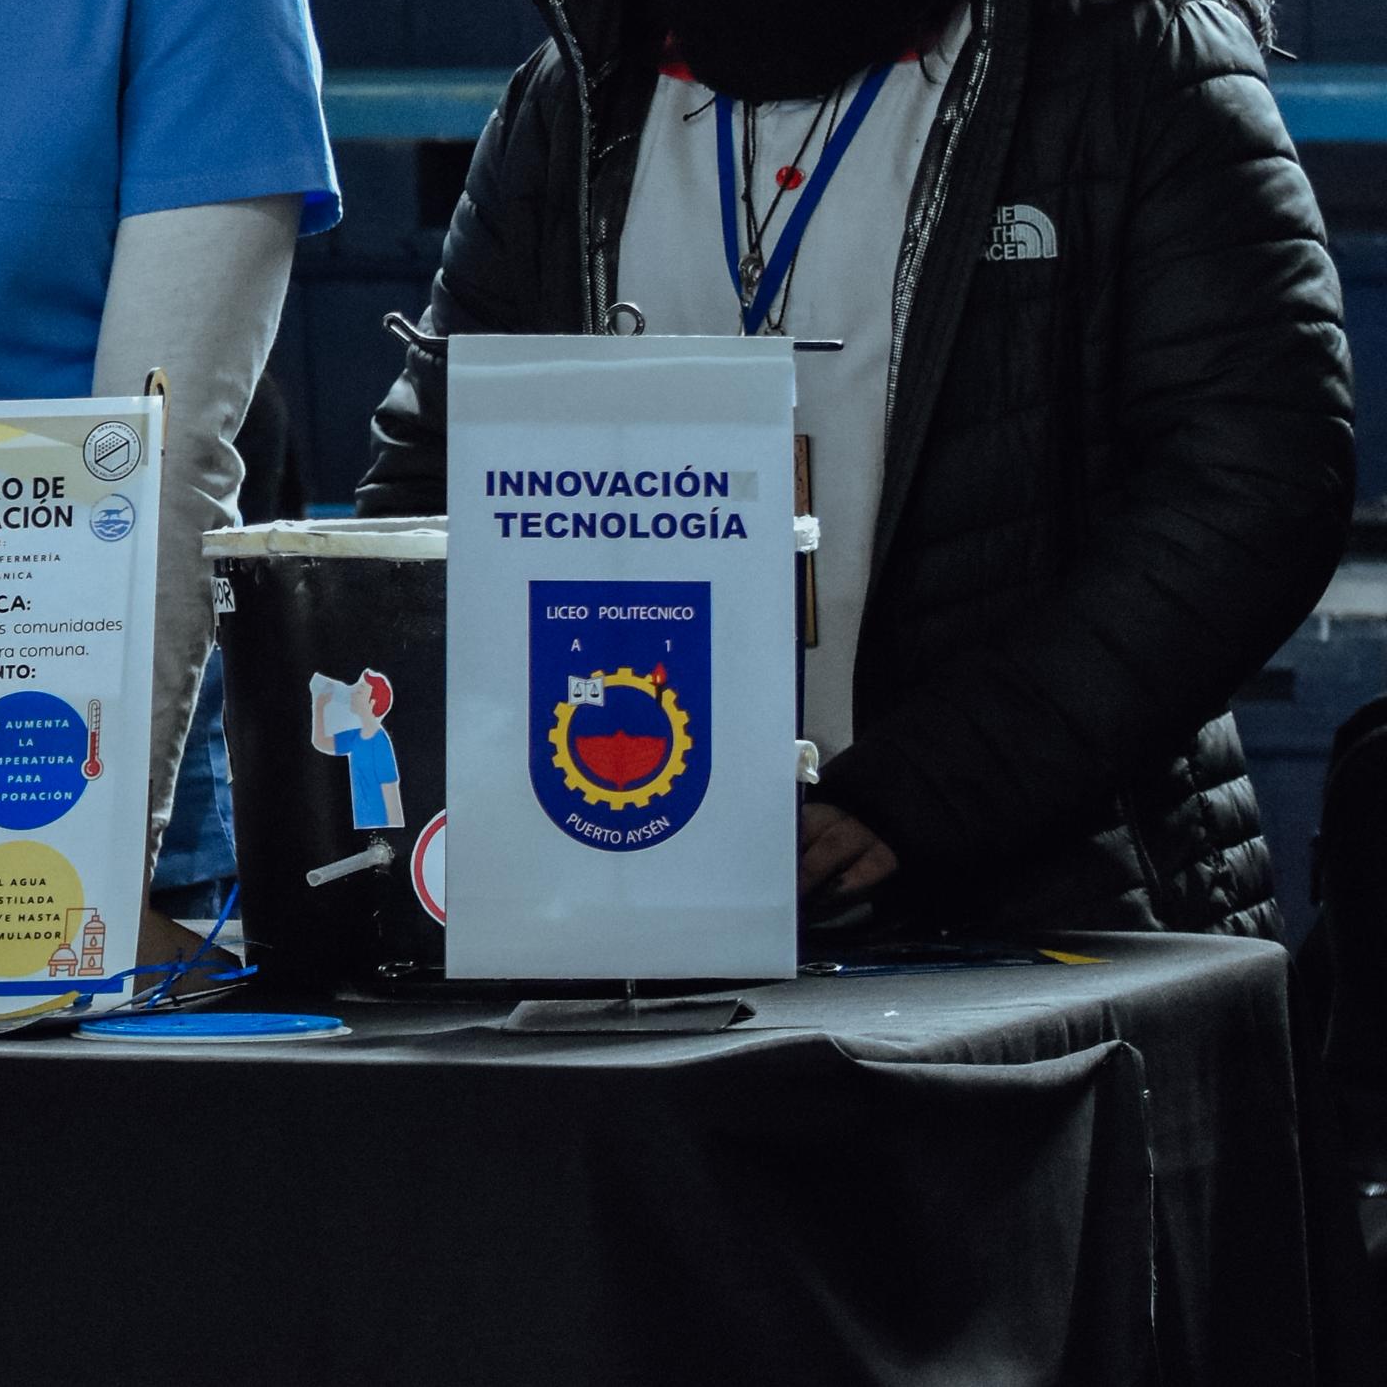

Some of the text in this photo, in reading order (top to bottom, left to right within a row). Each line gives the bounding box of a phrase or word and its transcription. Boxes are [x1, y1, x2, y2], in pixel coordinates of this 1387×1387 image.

[486, 464, 729, 498] INNOVACIÓN
[32, 476, 65, 502] DE
[493, 507, 748, 540] TECNOLOGÍA
[546, 605, 695, 621] LICEO POLITECNICO
[13, 617, 123, 635] comunidades
[570, 638, 671, 653] A 1
[5, 719, 70, 730] AUMENTA
[18, 738, 34, 747] LA
[7, 774, 41, 783] PARA
[566, 812, 671, 845] PUERTO AYSÉN
[9, 877, 47, 887] AGUA
[17, 913, 61, 922] HASTA
